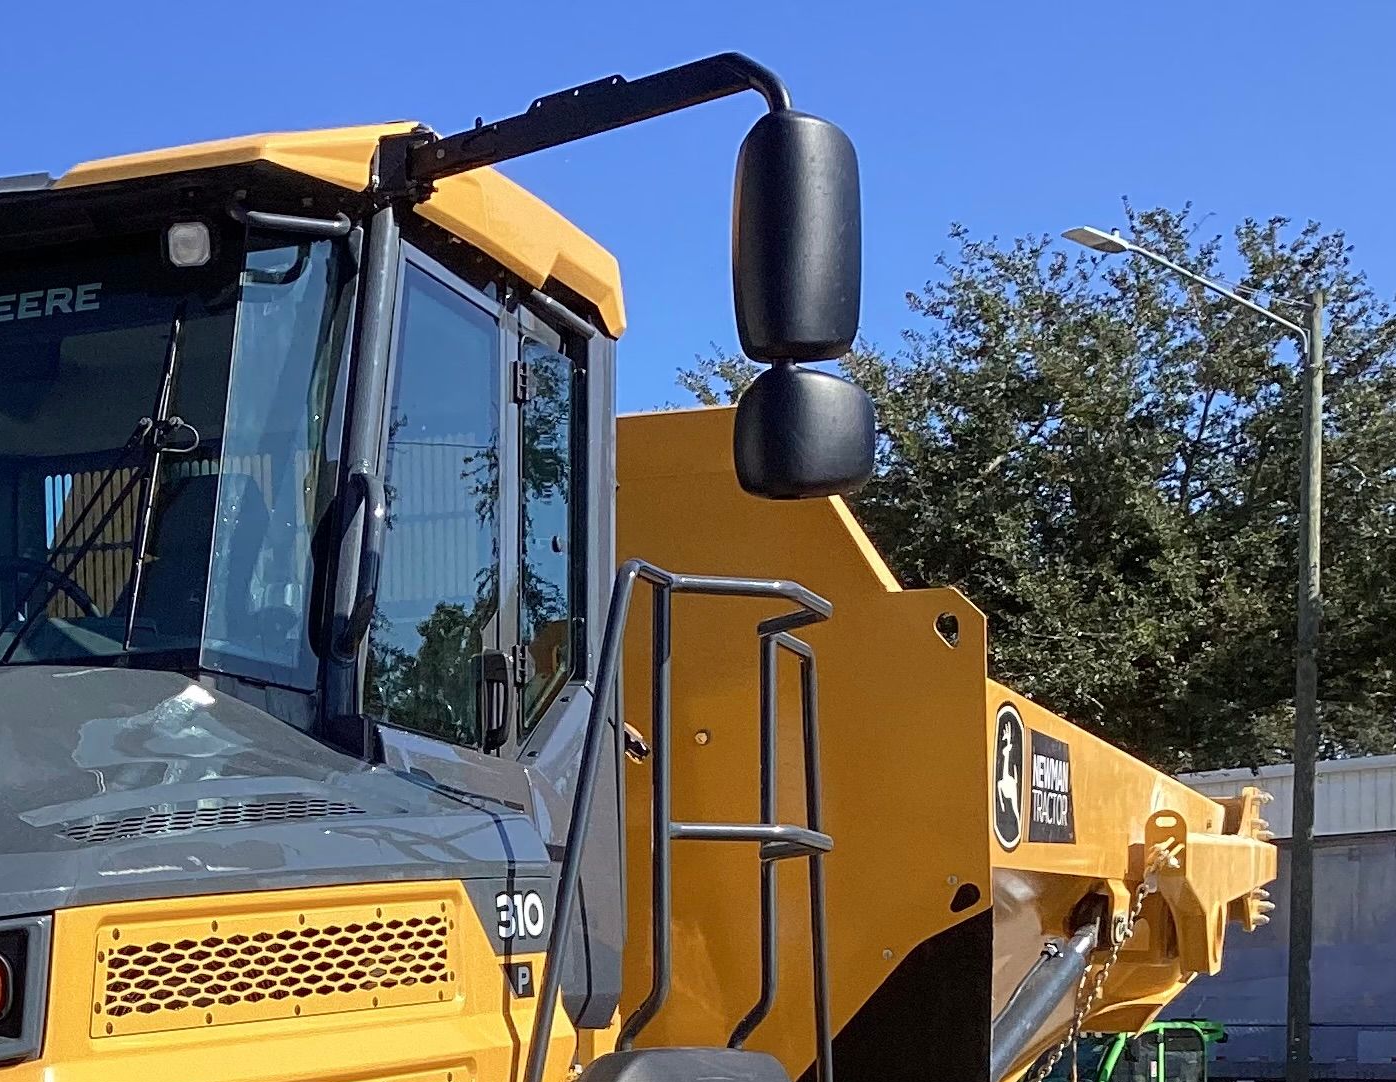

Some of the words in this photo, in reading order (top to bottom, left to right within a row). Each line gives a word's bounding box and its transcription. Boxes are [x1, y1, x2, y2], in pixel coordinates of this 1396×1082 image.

[1032, 753, 1070, 793] NEWMAN
[1031, 788, 1069, 827] TRACTOR
[495, 890, 545, 939] 310
[517, 966, 530, 995] P
